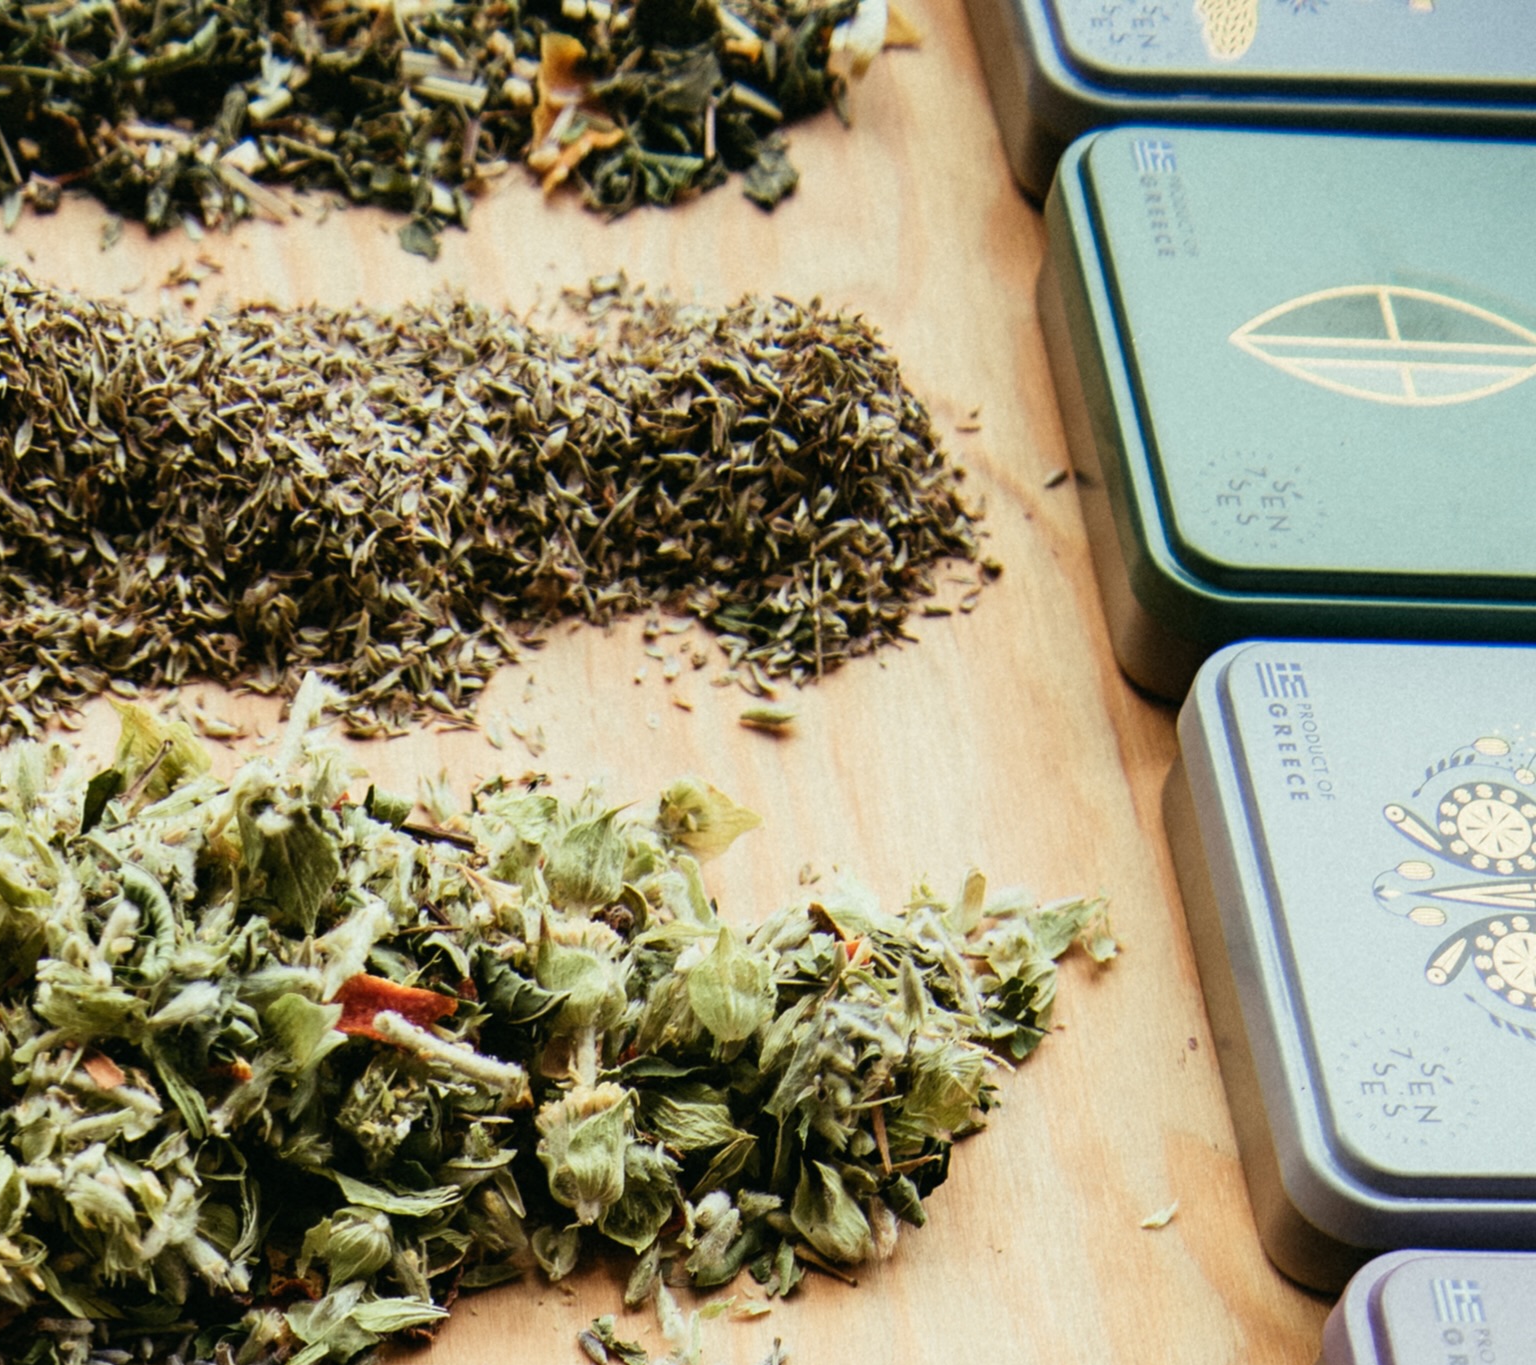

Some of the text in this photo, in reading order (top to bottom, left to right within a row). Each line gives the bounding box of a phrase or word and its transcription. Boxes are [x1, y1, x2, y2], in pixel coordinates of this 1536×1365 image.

[1139, 174, 1177, 257] GREECE
[1268, 703, 1310, 801] GREECE
[1297, 703, 1336, 801] PRODUCT OF
